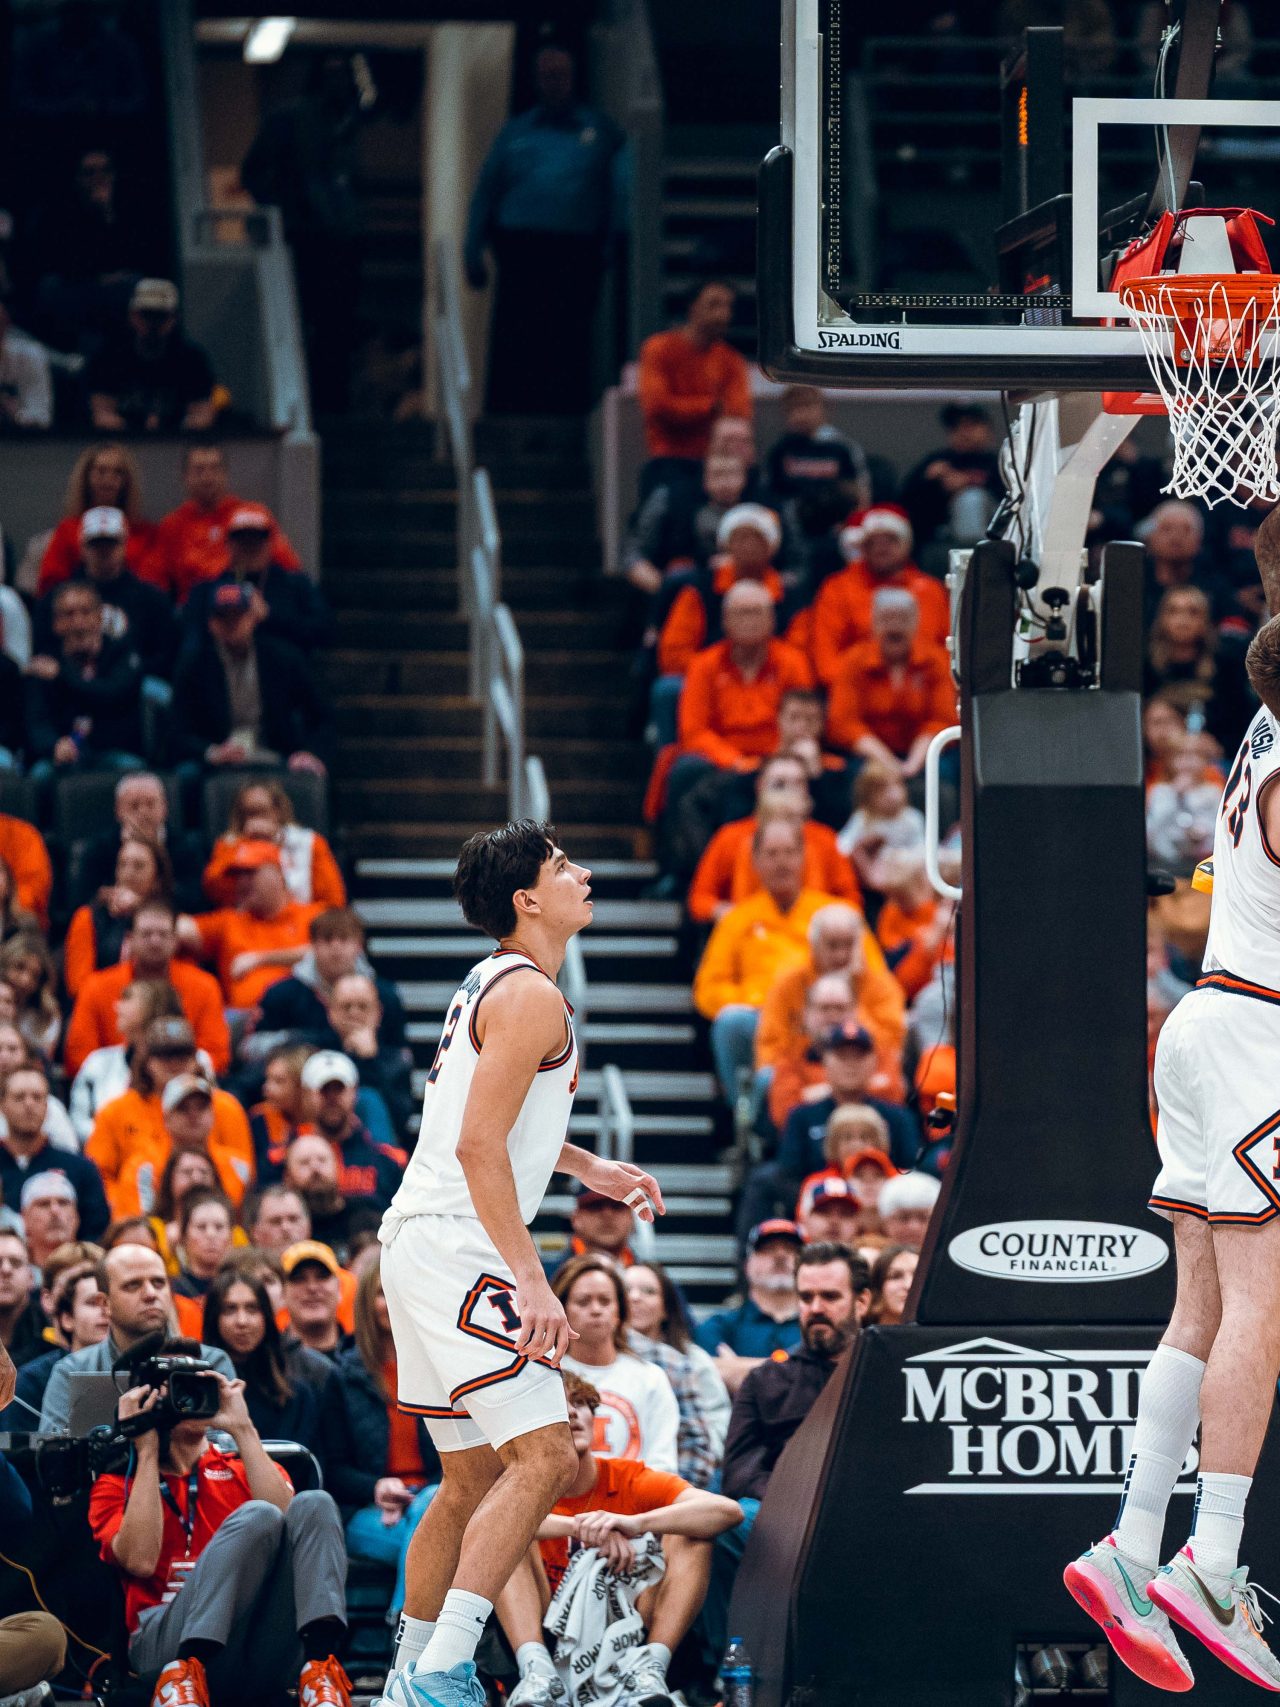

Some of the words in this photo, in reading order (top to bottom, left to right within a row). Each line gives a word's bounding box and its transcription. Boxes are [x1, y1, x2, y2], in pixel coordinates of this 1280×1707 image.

[818, 331, 900, 350] SPALDING
[1221, 740, 1252, 849] 13
[427, 1004, 463, 1085] 2
[979, 1231, 1139, 1258] COUNTRY
[1010, 1259, 1110, 1272] FINANCIAL
[901, 1367, 1149, 1422] McBRI
